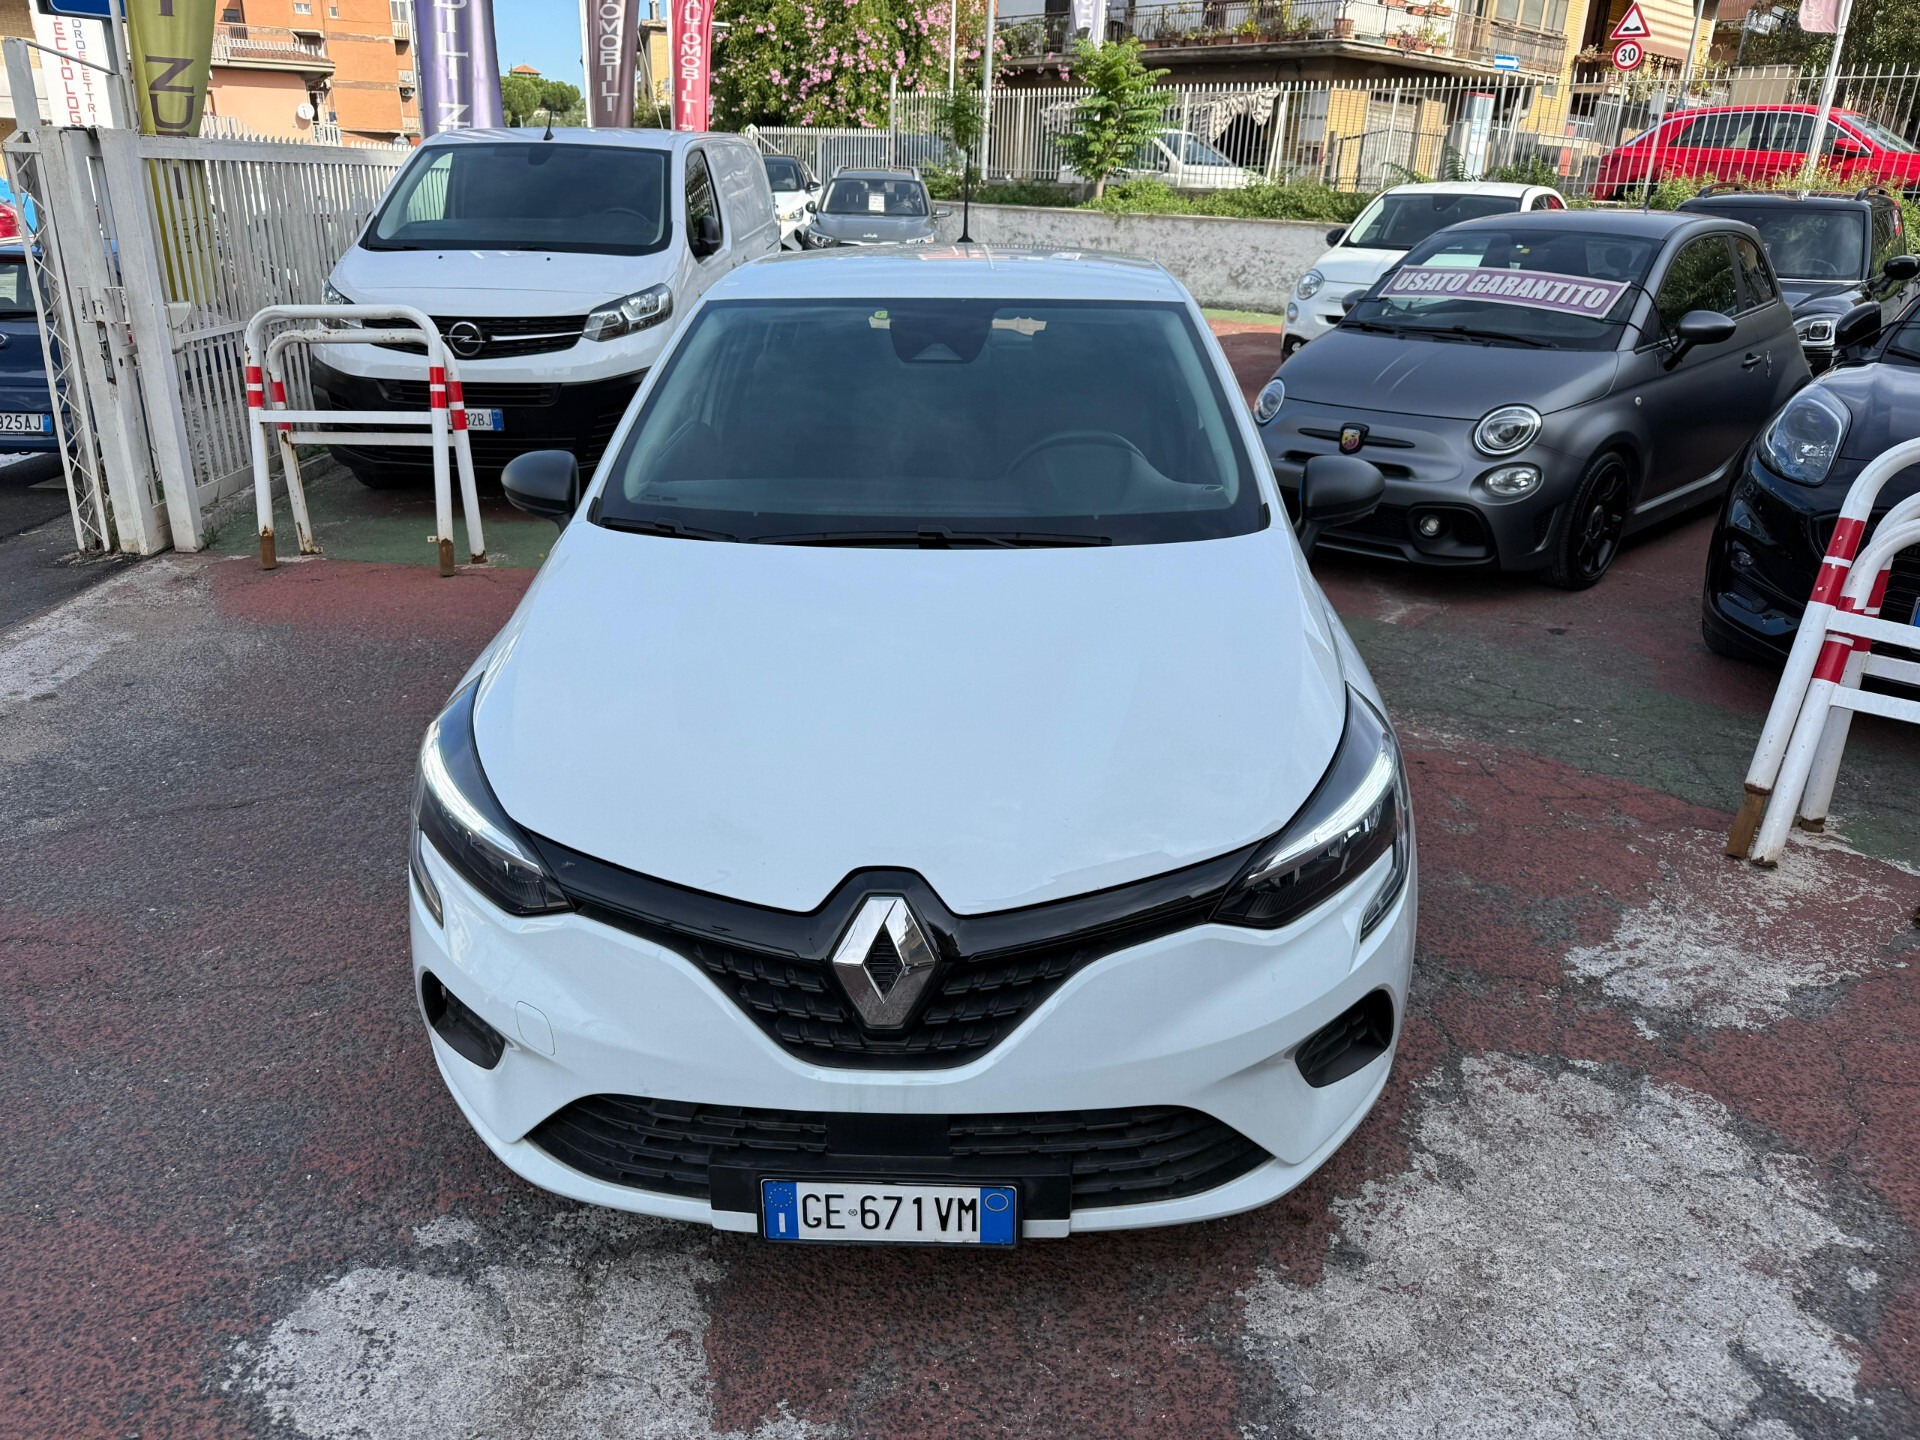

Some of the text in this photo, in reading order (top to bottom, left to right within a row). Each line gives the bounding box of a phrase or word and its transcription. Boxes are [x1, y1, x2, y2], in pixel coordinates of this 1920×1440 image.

[600, 0, 622, 112] OMOBILI
[1619, 47, 1636, 62] 30
[1393, 271, 1610, 309] USATO GARANTITO
[801, 1193, 846, 1230] GE
[859, 1194, 978, 1232] 671VM
